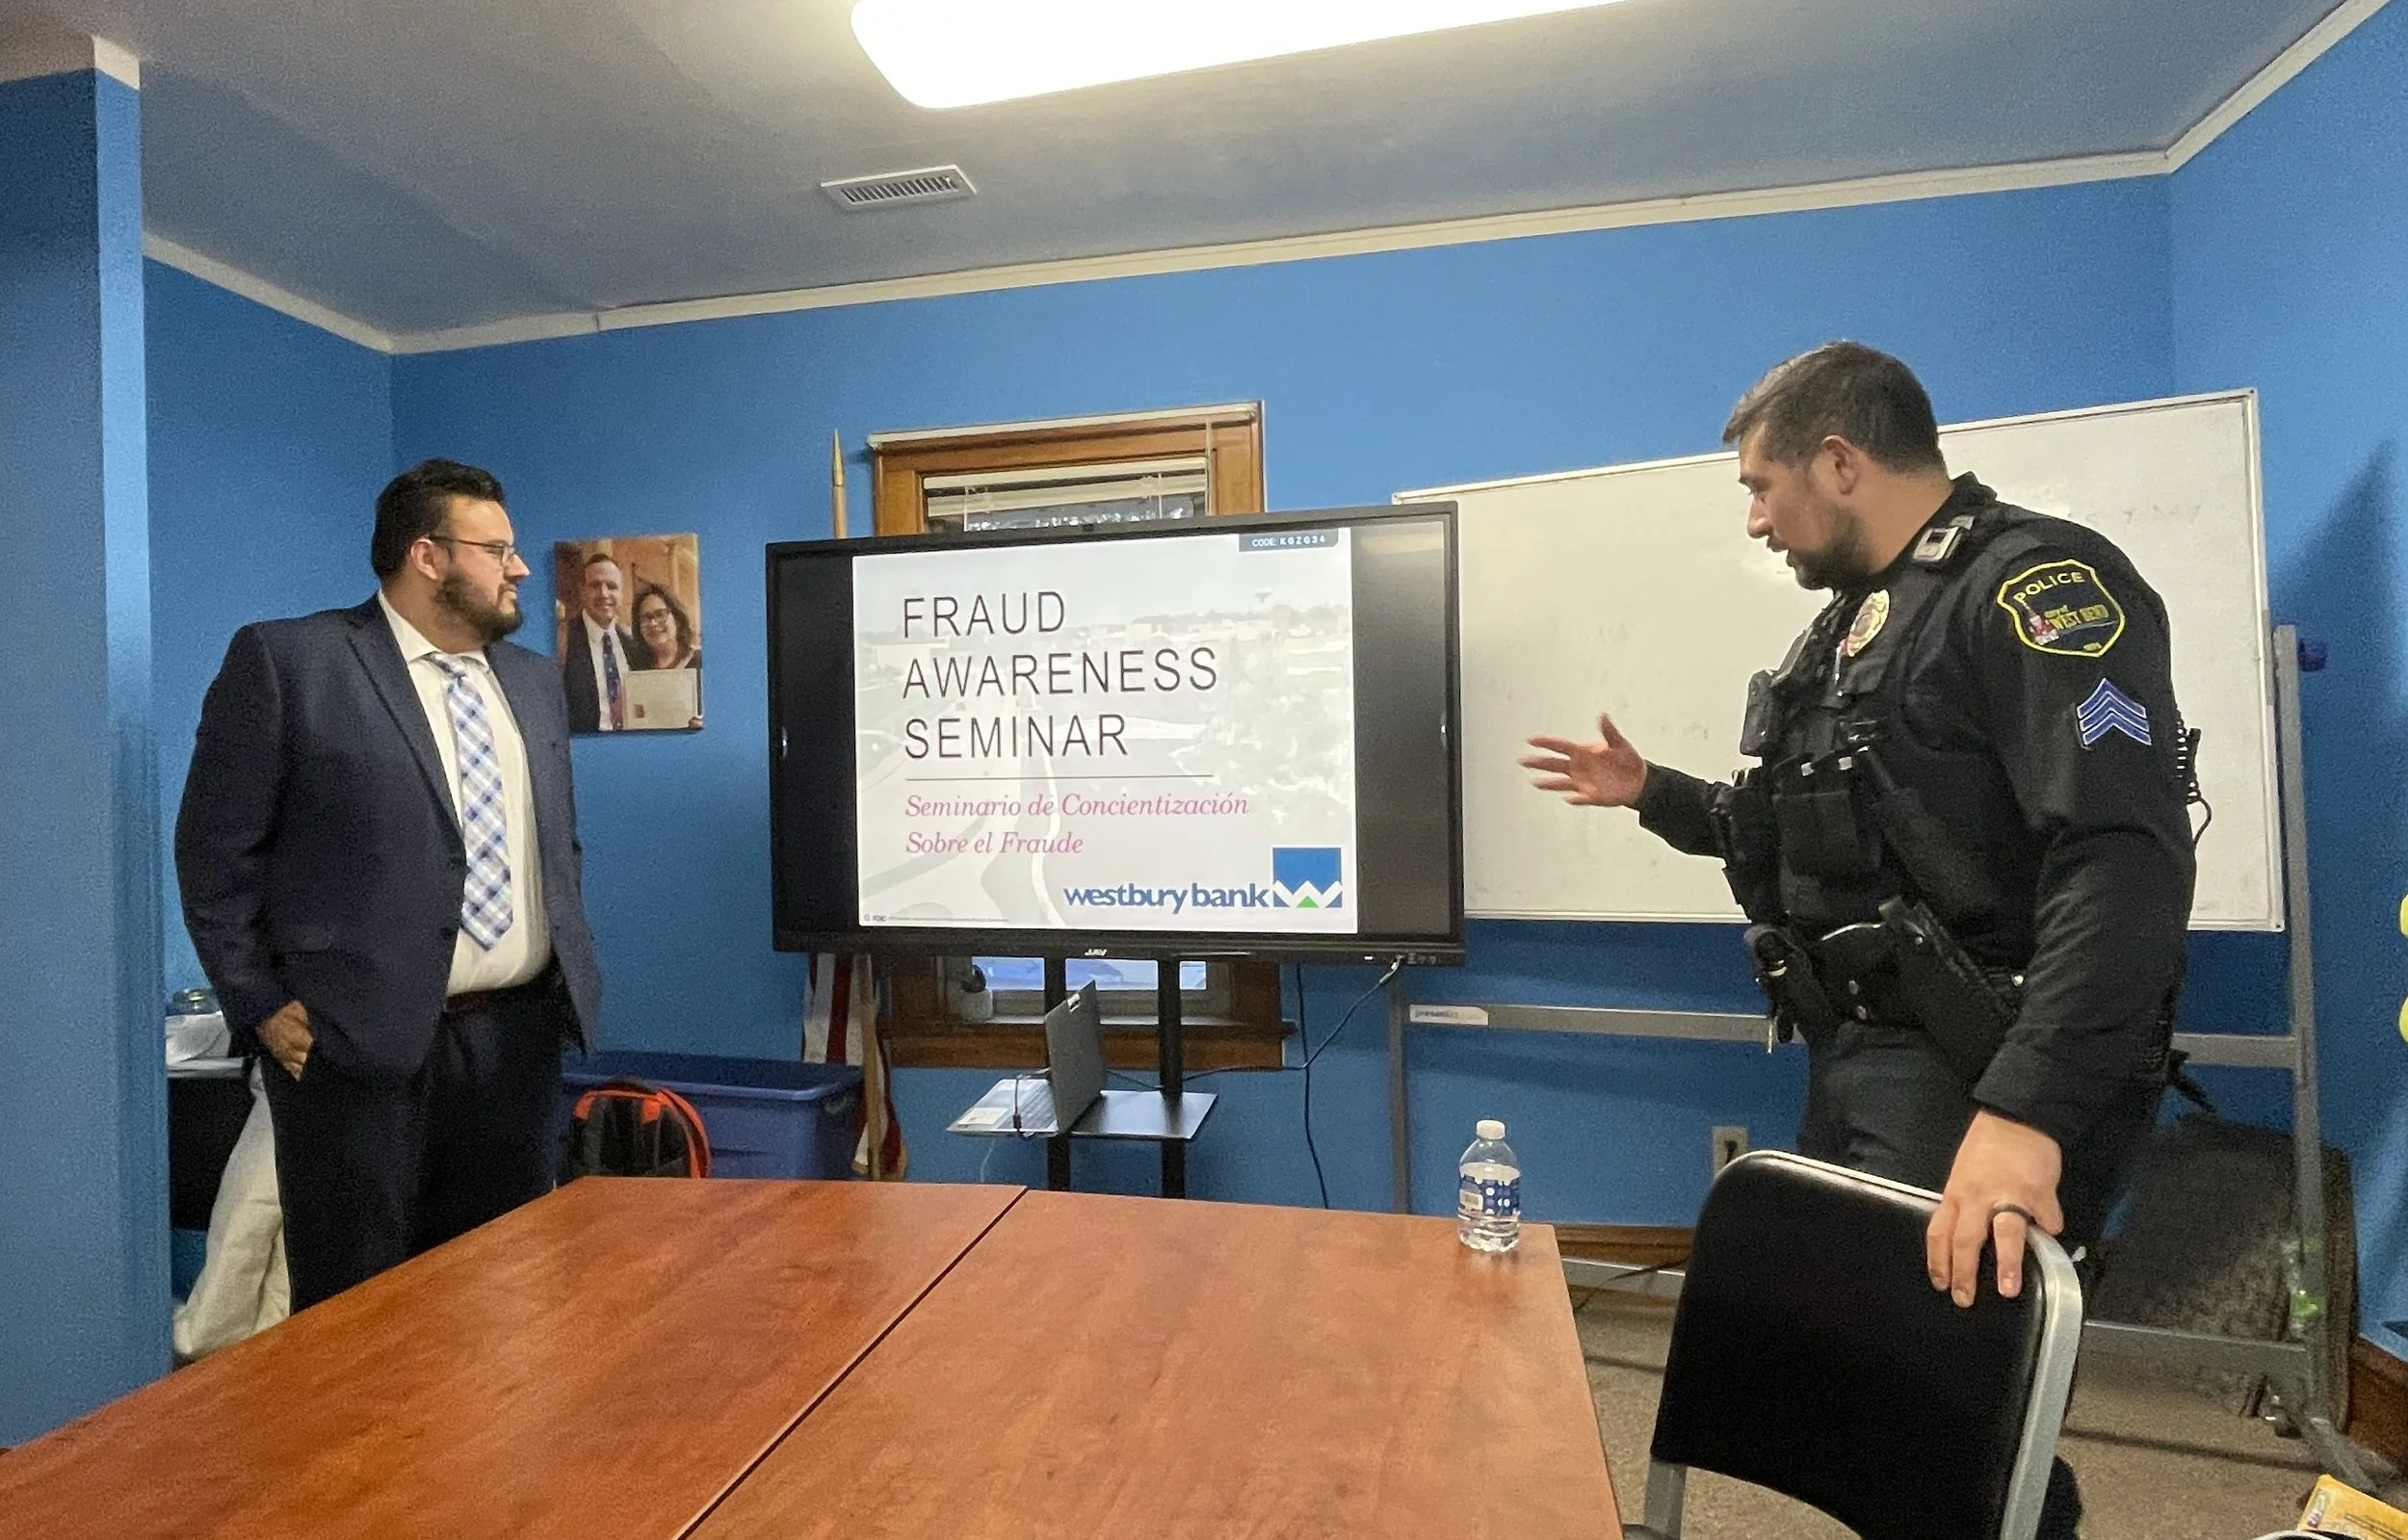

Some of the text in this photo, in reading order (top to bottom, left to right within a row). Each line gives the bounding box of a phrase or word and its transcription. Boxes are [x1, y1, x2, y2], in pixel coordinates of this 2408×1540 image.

[2013, 572, 2085, 603] POLICE
[903, 591, 1064, 638] FRAUD
[903, 647, 1217, 698] AWARENESS
[904, 714, 1127, 759] SEMINAR
[905, 793, 1249, 817] Seminario de Concientización
[905, 832, 1084, 854] Sobre el Fraude
[1063, 883, 1269, 915] westbury bank
